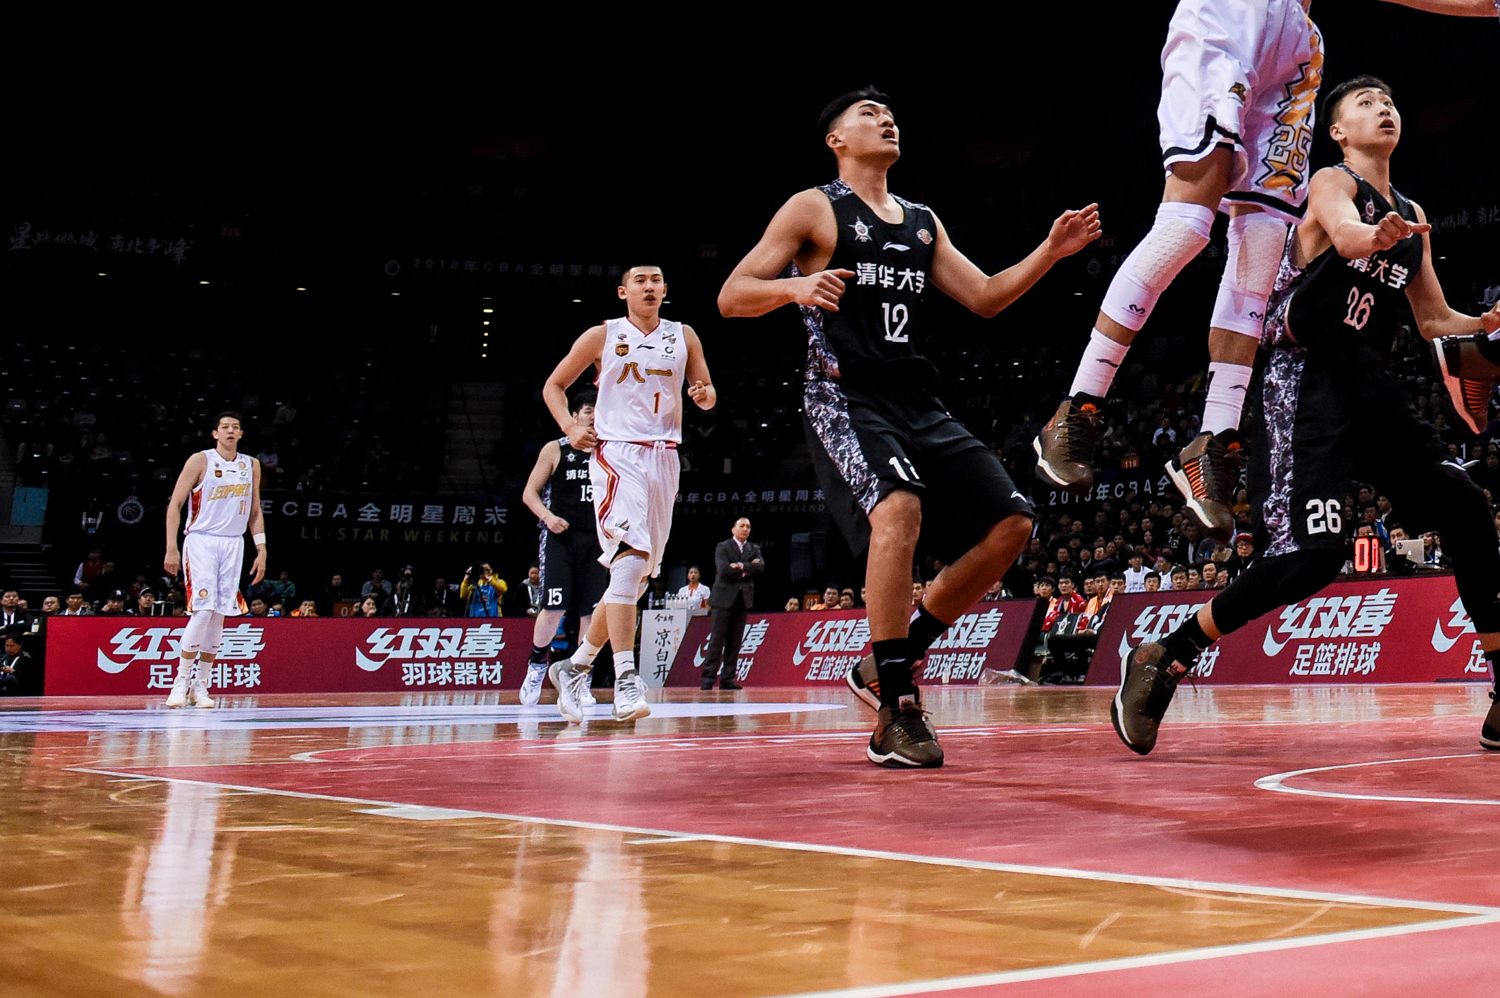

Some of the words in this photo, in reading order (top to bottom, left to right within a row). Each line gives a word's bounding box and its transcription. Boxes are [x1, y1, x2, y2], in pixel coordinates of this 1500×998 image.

[1266, 123, 1313, 172] 25
[856, 262, 925, 294] 清华大学
[882, 302, 909, 343] 12
[1343, 286, 1375, 331] 26
[617, 362, 673, 384] 八一
[654, 392, 661, 414] 1
[566, 469, 591, 480] 清华
[580, 484, 594, 502] 15
[1306, 498, 1342, 535] 26
[403, 529, 505, 545] WEEKEND
[547, 588, 563, 606] 15
[1262, 588, 1399, 657] 红双喜
[356, 623, 506, 672] 红双喜
[653, 628, 671, 683] 凉白开
[793, 618, 872, 666] 红双喜
[401, 661, 504, 686] 羽球器材
[923, 652, 988, 680] 羽球器材
[1289, 641, 1381, 676] 足篮排球
[147, 663, 262, 689] 足排球
